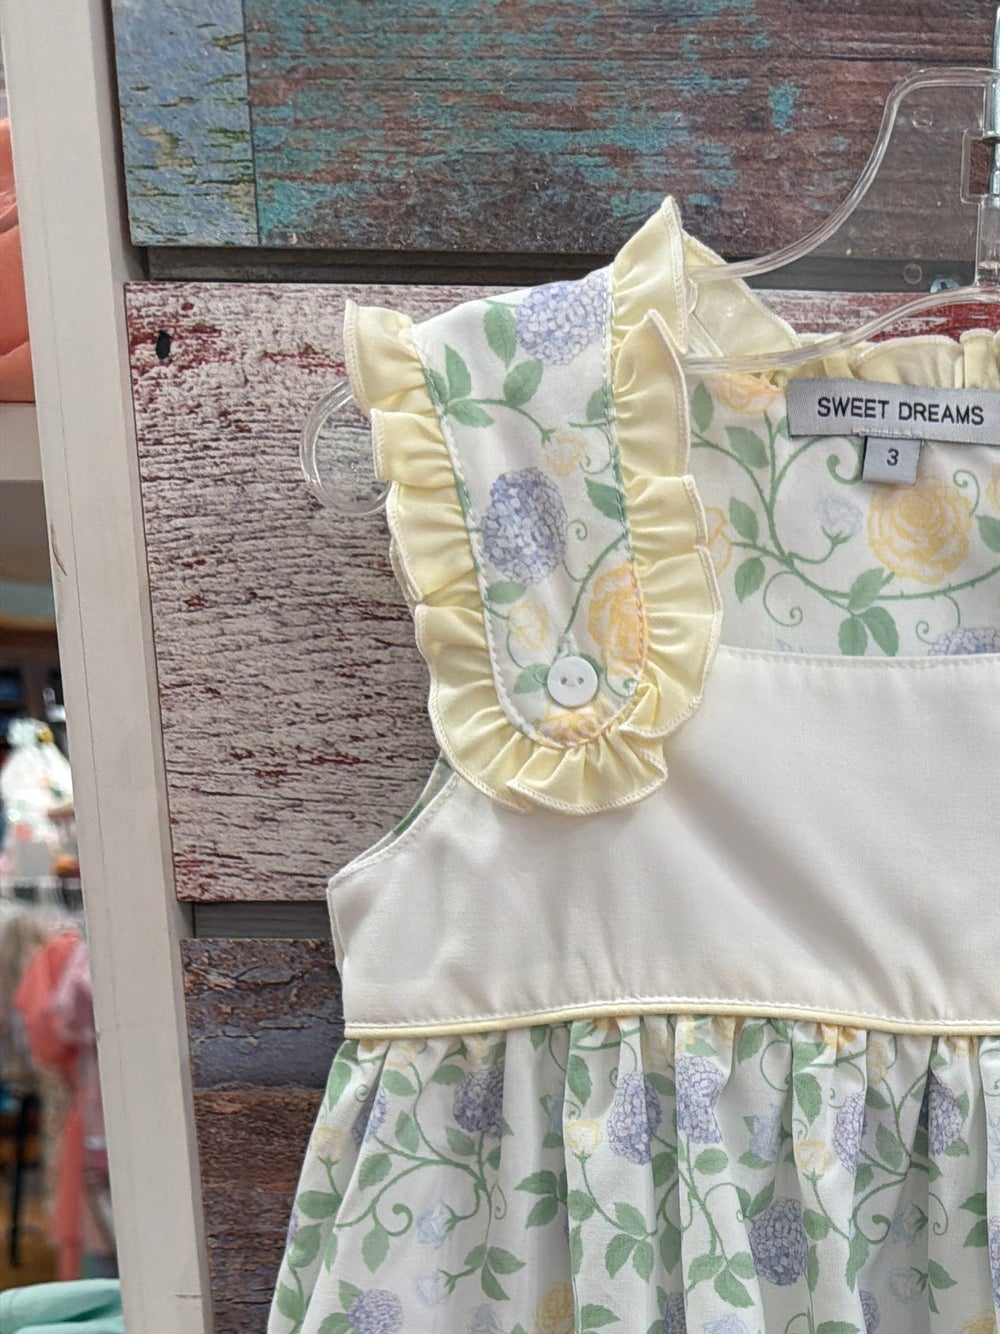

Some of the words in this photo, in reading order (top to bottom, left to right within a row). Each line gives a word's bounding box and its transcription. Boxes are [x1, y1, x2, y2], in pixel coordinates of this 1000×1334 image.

[816, 396, 890, 419] SWEET
[898, 402, 985, 426] DREAMS
[886, 448, 899, 466] 3
